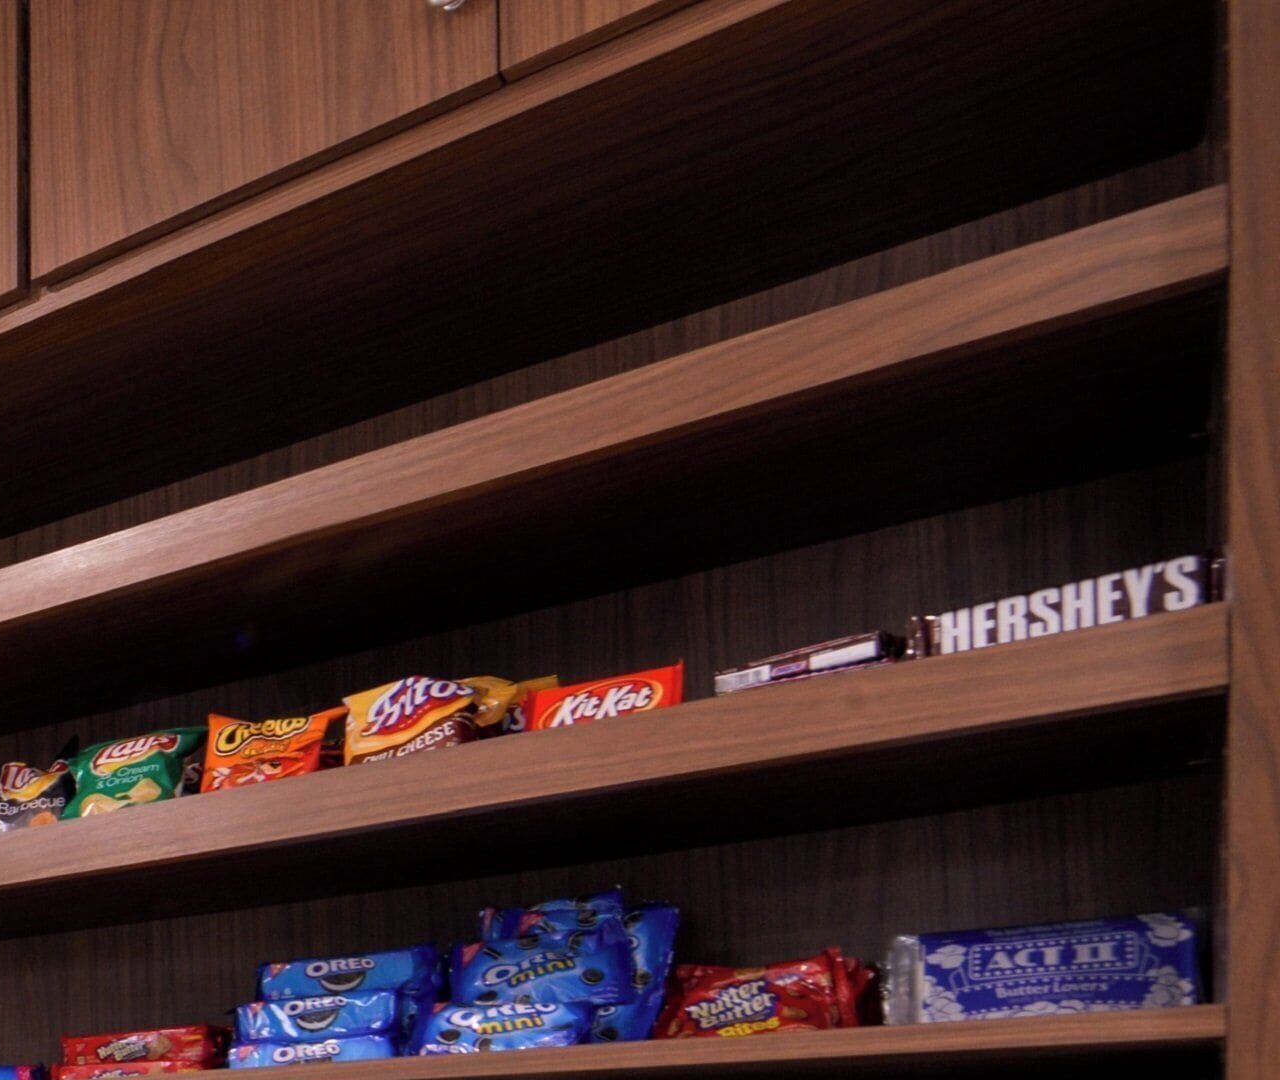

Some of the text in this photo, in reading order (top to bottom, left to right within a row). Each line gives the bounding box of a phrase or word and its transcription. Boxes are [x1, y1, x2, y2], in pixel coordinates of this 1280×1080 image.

[940, 555, 1199, 656] HERSHEY'S
[361, 677, 476, 738] Fritos
[395, 720, 455, 758] CHEESE
[305, 955, 375, 978] OREO
[986, 941, 1119, 970] ACT II
[510, 957, 575, 986] mini
[684, 980, 766, 1020] Nutter
[995, 982, 1051, 999] Butter
[283, 995, 348, 1017] OREO
[476, 1014, 544, 1035] mini
[272, 1042, 341, 1064] OREO
